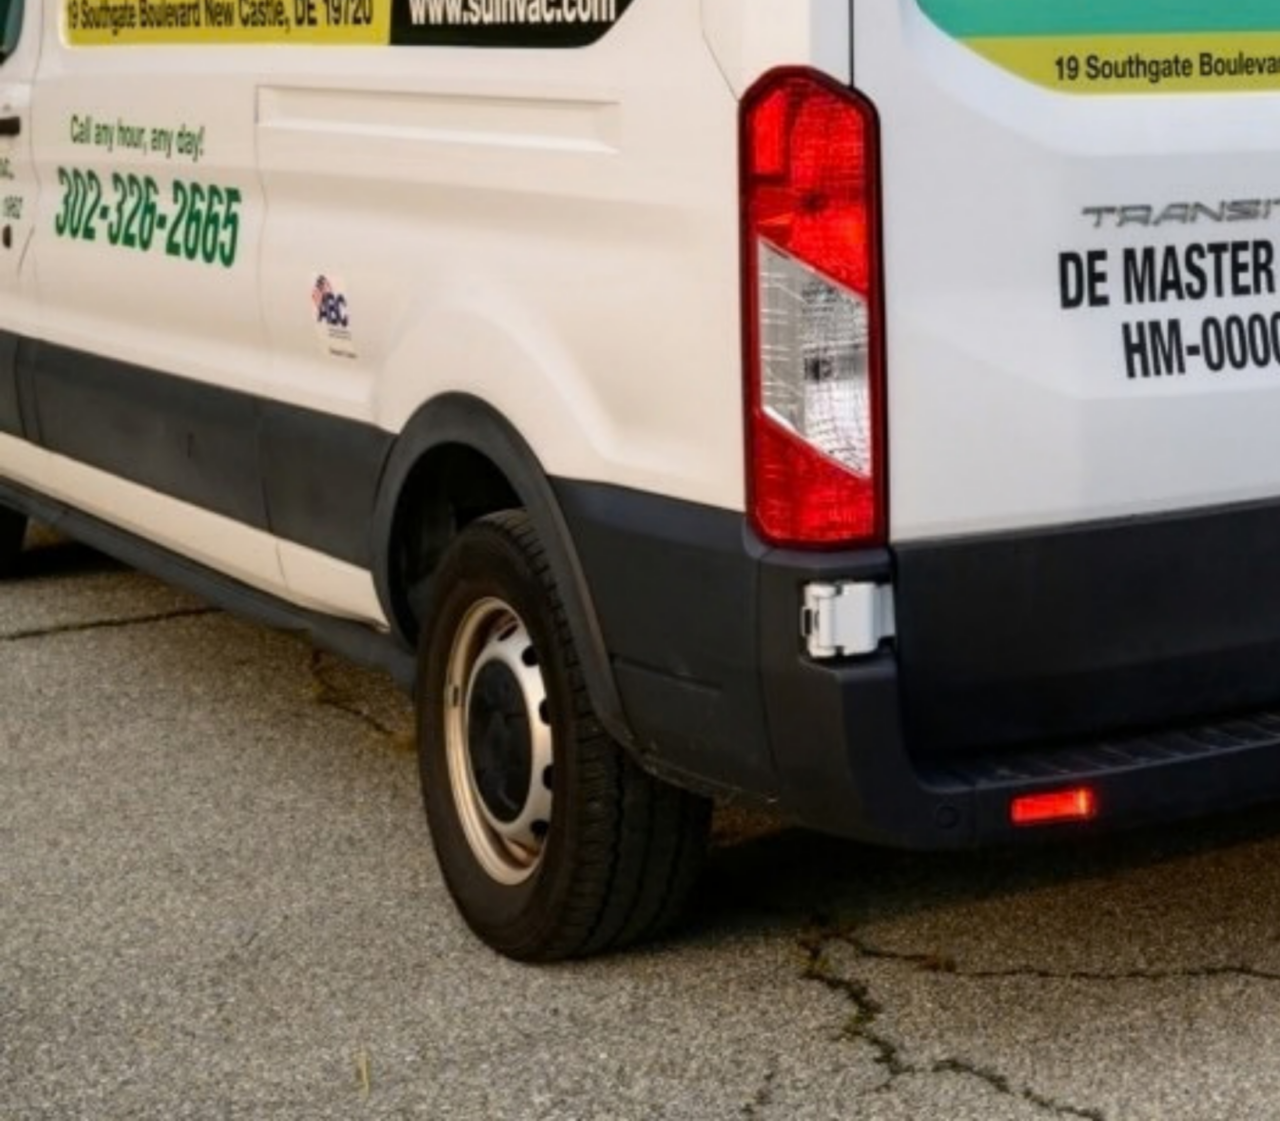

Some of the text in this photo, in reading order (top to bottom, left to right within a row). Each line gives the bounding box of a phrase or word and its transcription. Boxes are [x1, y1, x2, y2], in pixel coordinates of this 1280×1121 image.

[81, 0, 136, 35] Southgate
[1055, 55, 1079, 80] 19
[1085, 53, 1193, 83] Southgate
[70, 115, 205, 162] Call any hour, any day!
[55, 165, 242, 268] 302-326-2665
[1059, 250, 1110, 309] DE
[1123, 239, 1276, 304] MASTER
[317, 292, 348, 327] ABC
